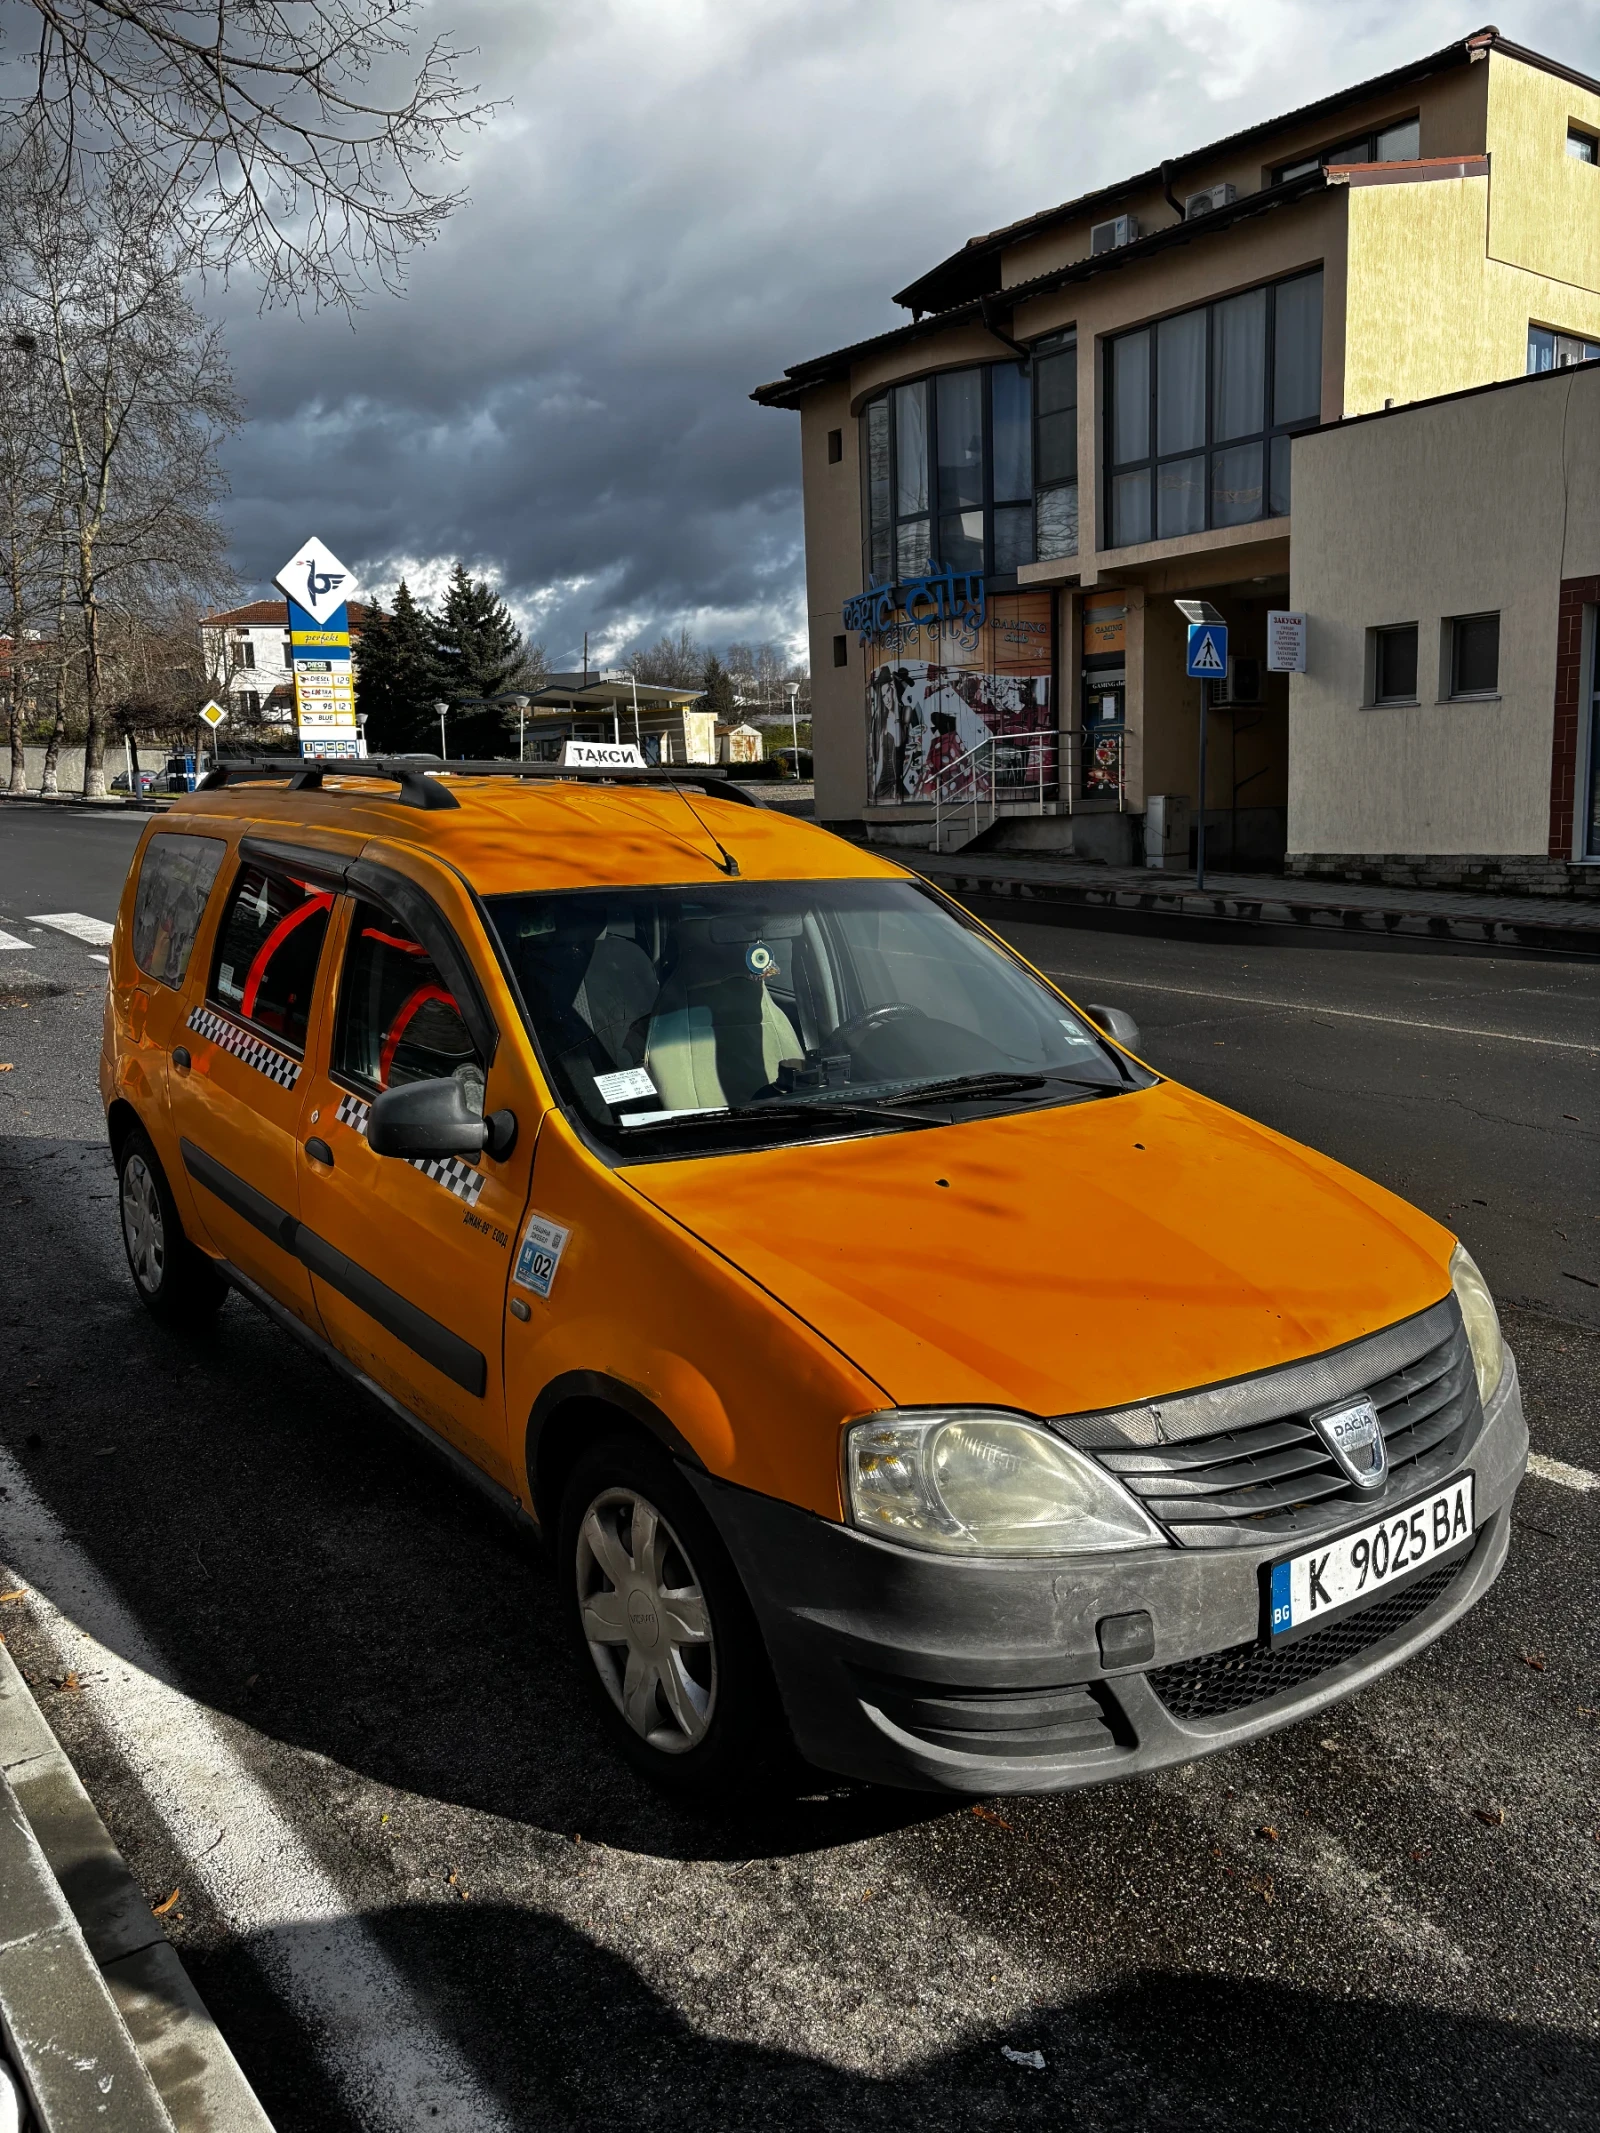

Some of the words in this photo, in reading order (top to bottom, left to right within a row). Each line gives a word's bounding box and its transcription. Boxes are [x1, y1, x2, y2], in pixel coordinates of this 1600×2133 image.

[902, 559, 986, 631] city
[990, 617, 1047, 634] GAMING
[1095, 624, 1123, 634] GAMING
[1274, 617, 1302, 625] ЗАКУСКИ
[305, 633, 339, 644] perfekt
[1004, 633, 1030, 644] club
[573, 747, 635, 764] ТАКСИ
[533, 1254, 552, 1279] 02
[1333, 1415, 1373, 1437] DACIA
[1309, 1552, 1332, 1611] K
[1274, 1604, 1290, 1625] BG
